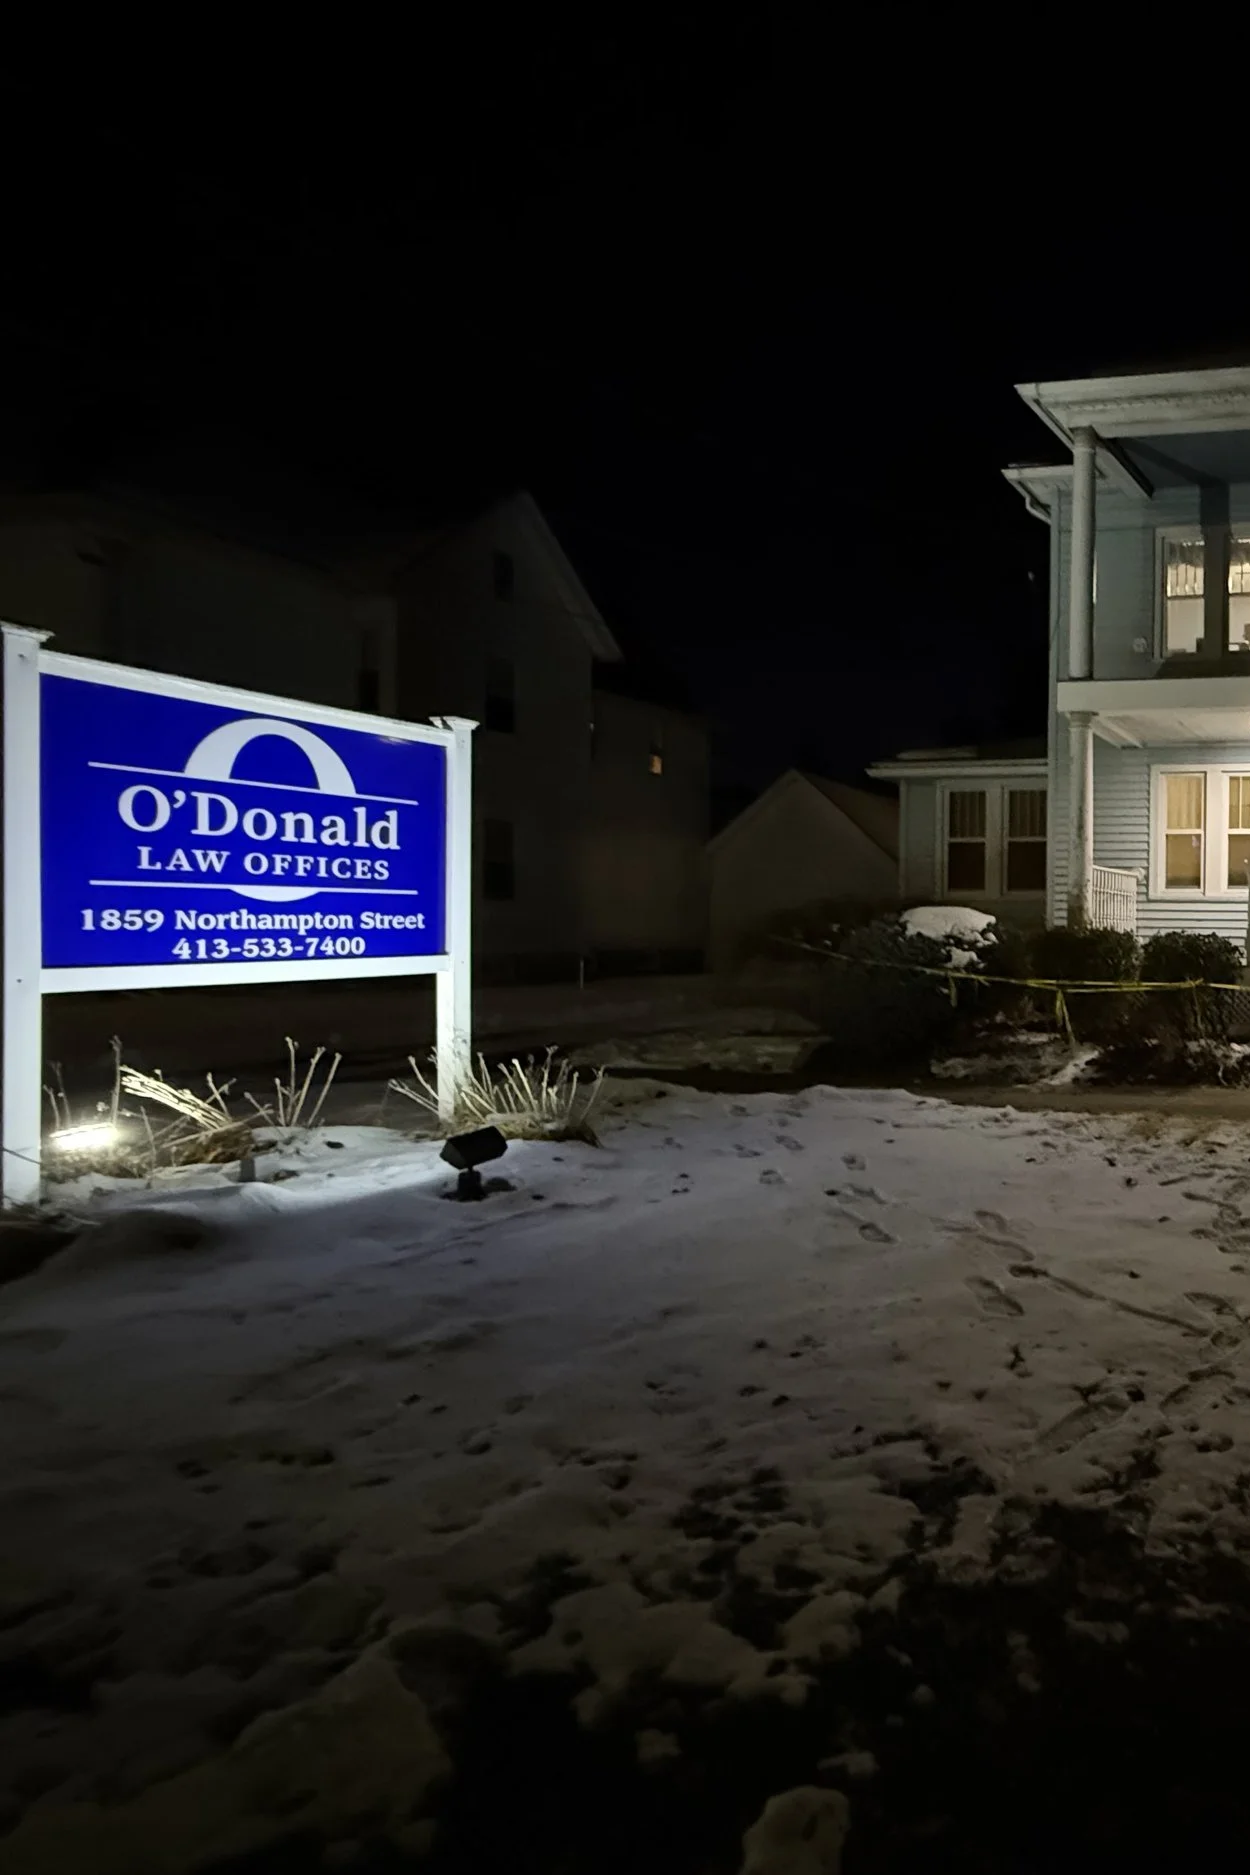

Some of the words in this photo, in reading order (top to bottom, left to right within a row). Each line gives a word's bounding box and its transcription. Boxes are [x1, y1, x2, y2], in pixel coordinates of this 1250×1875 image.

[118, 784, 400, 850] O'Donald
[137, 846, 231, 873] LAW
[243, 852, 390, 881] OFFICES
[80, 908, 165, 932] 1859
[174, 908, 354, 935] Northampton
[359, 911, 425, 930] Street
[171, 937, 366, 959] 413-533-7400
